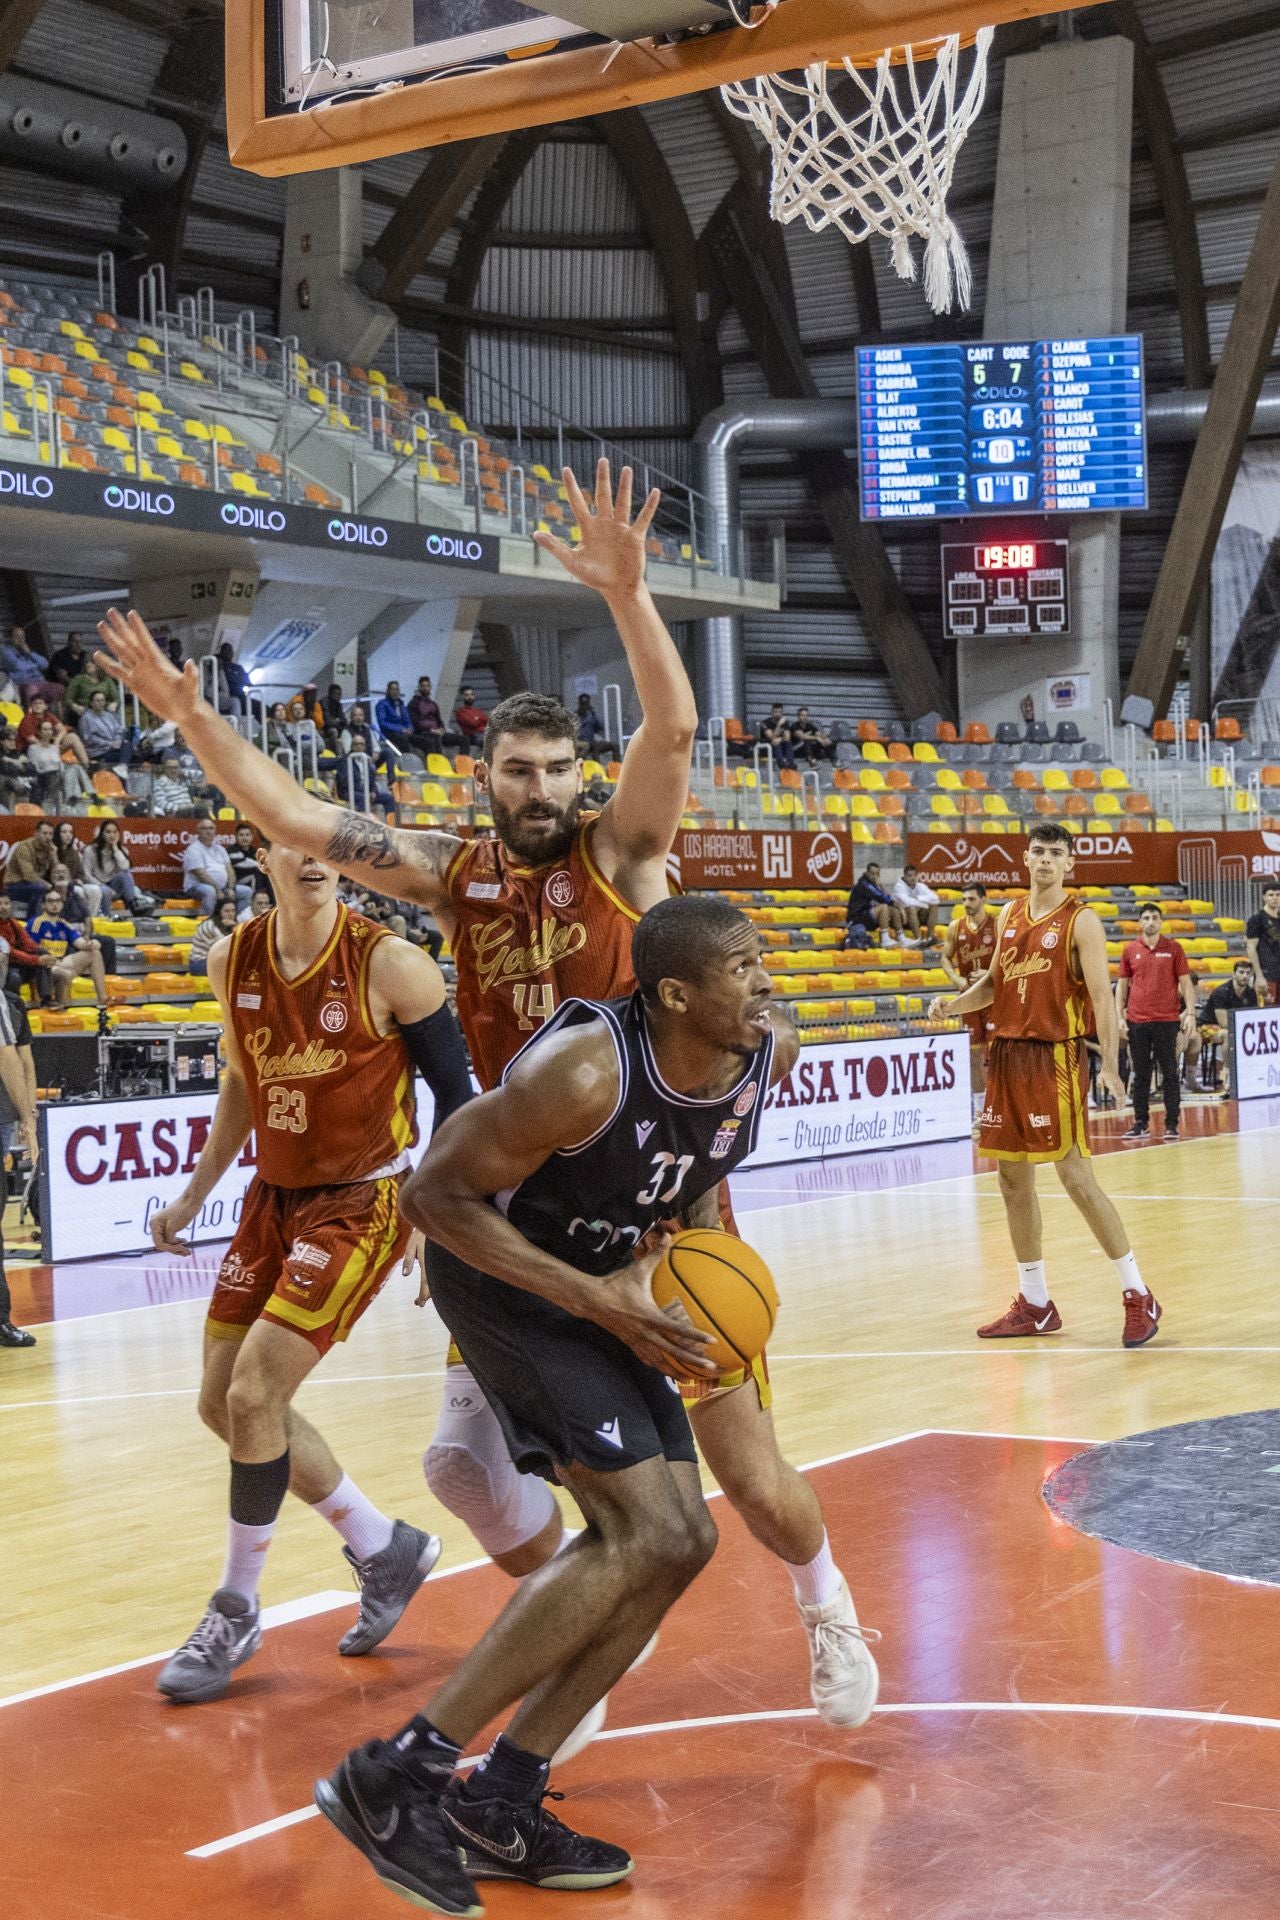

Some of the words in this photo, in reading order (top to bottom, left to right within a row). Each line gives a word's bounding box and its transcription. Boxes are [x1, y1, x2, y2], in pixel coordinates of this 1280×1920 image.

[967, 347, 995, 361] CART
[1052, 340, 1087, 354] CLARKE
[973, 363, 986, 385] 5
[1009, 362, 1022, 384] 7
[1052, 369, 1075, 382] VILA
[1132, 366, 1140, 379] 3
[1053, 383, 1090, 397] BLANCO
[877, 404, 918, 418] ALBERTO
[983, 407, 1024, 430] 6:04
[1054, 411, 1095, 425] IGLESIAS
[1134, 422, 1142, 435] 2
[878, 433, 912, 446] SASTRE
[995, 444, 1009, 459] 10
[1055, 454, 1086, 467] COPES
[1135, 465, 1143, 478] 2
[957, 473, 966, 486] 3
[880, 489, 920, 502] STEPHEN
[957, 487, 966, 500] 2
[1056, 482, 1097, 496] BELLVER
[104, 485, 175, 515] ODILO
[880, 502, 936, 517] SMALLWOOD
[221, 503, 286, 532] ODILO
[327, 519, 388, 547] ODILO
[426, 534, 482, 560] ODILO
[984, 544, 1034, 569] 19:08
[122, 830, 161, 845] Puerto
[163, 830, 178, 845] de
[180, 831, 236, 845] Caena
[703, 864, 737, 877] HOTEL
[512, 983, 555, 1031] 14
[764, 1060, 840, 1110] ASA
[844, 1038, 955, 1101] TOMÁS
[266, 1085, 308, 1134] 23
[794, 1118, 842, 1155] Grupo
[845, 1110, 887, 1143] desde
[891, 1108, 922, 1138] 1936
